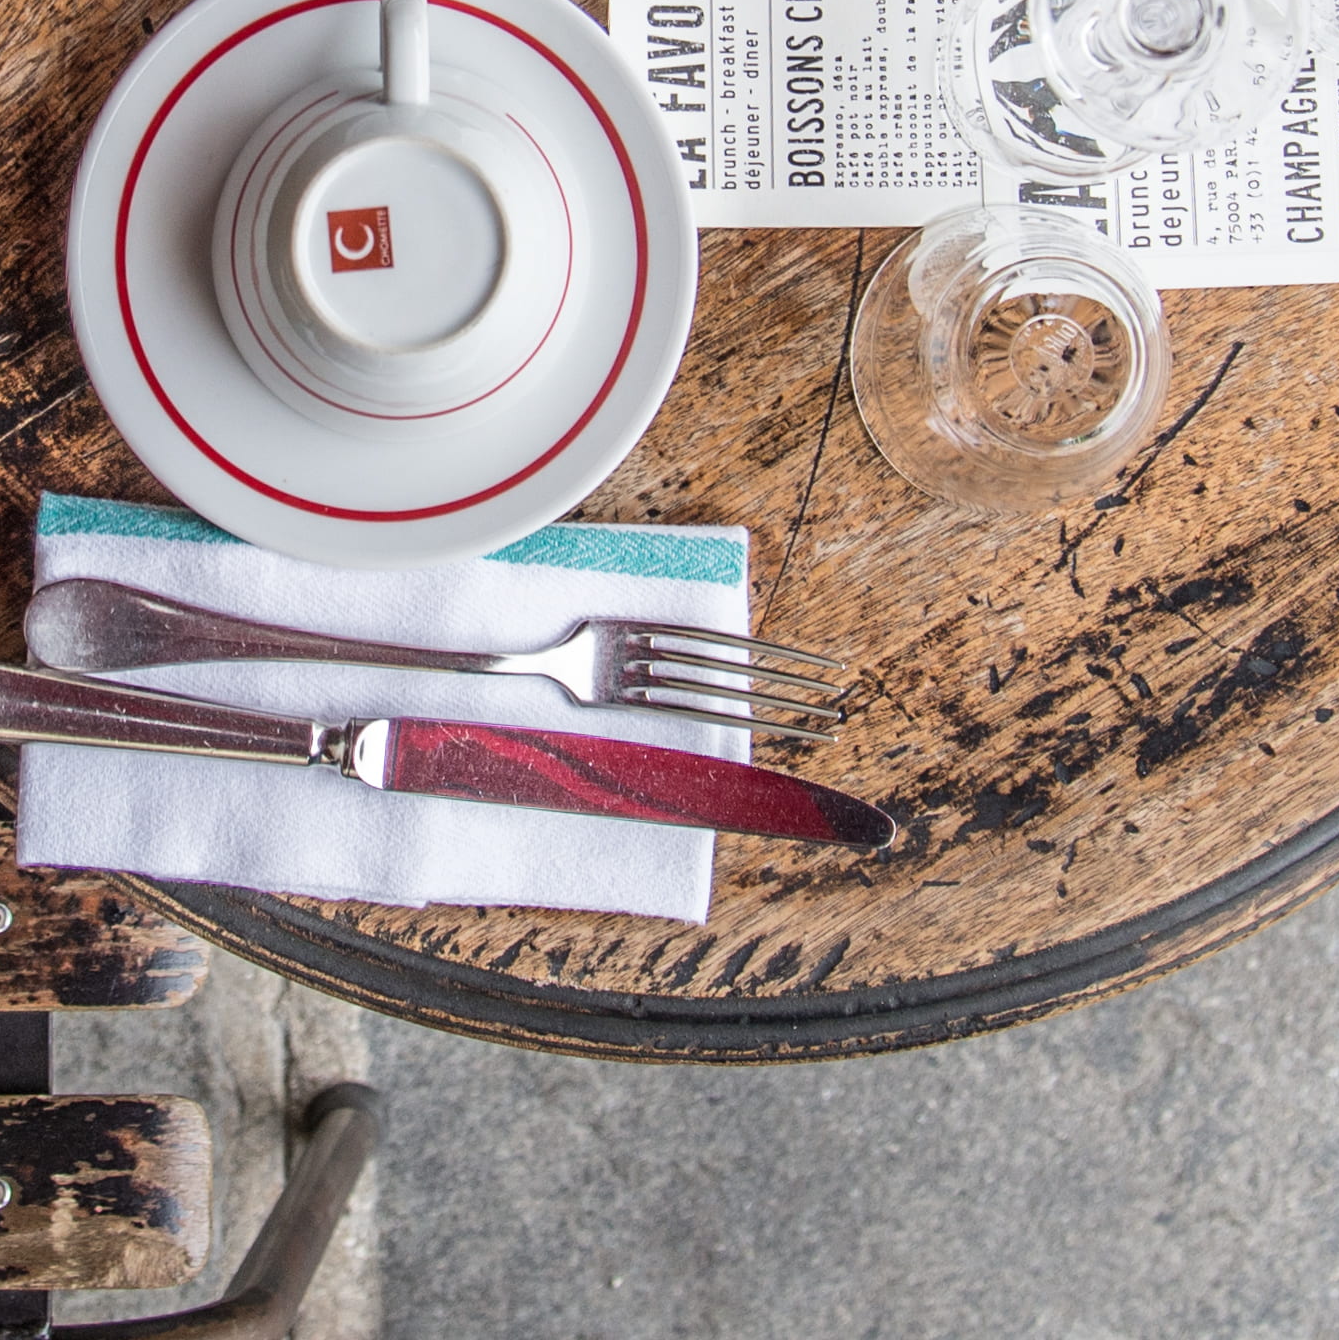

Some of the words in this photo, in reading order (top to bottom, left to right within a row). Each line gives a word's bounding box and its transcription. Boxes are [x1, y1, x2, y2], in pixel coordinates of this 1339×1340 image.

[718, 5, 736, 99] breakfast
[906, 26, 916, 43] la
[743, 29, 760, 79] dîner
[862, 35, 872, 72] lait
[906, 54, 917, 72] de
[832, 55, 843, 92] déca
[847, 64, 858, 101] noir
[864, 83, 873, 101] au
[878, 46, 891, 120] express,
[786, 35, 824, 188] BOISSONS
[848, 112, 860, 140] pot
[863, 112, 875, 140] pot
[892, 93, 903, 139] crème
[906, 83, 918, 158] chocolat
[744, 104, 764, 190] déjeuner
[834, 105, 846, 188] Expresso,
[921, 93, 936, 188] Cappuccino
[938, 122, 948, 139] ou
[1280, 49, 1324, 244] CHAMPAGN
[722, 124, 737, 190] brunch
[848, 152, 859, 188] Café
[863, 152, 874, 188] Café
[878, 132, 890, 188] Double
[892, 152, 904, 188] Café
[936, 151, 948, 188] Café
[952, 151, 963, 188] Lait
[966, 150, 978, 188] Infu
[1204, 148, 1216, 168] de
[1225, 139, 1239, 180] PAR
[908, 170, 919, 188] Le
[1206, 181, 1218, 212] rue
[1129, 170, 1151, 248] brunc
[1160, 154, 1188, 247] dejeun
[1226, 191, 1243, 244] 75004
[377, 209, 390, 266] CHOMETTE
[1205, 226, 1222, 245] 4,
[1249, 213, 1264, 244] +33
